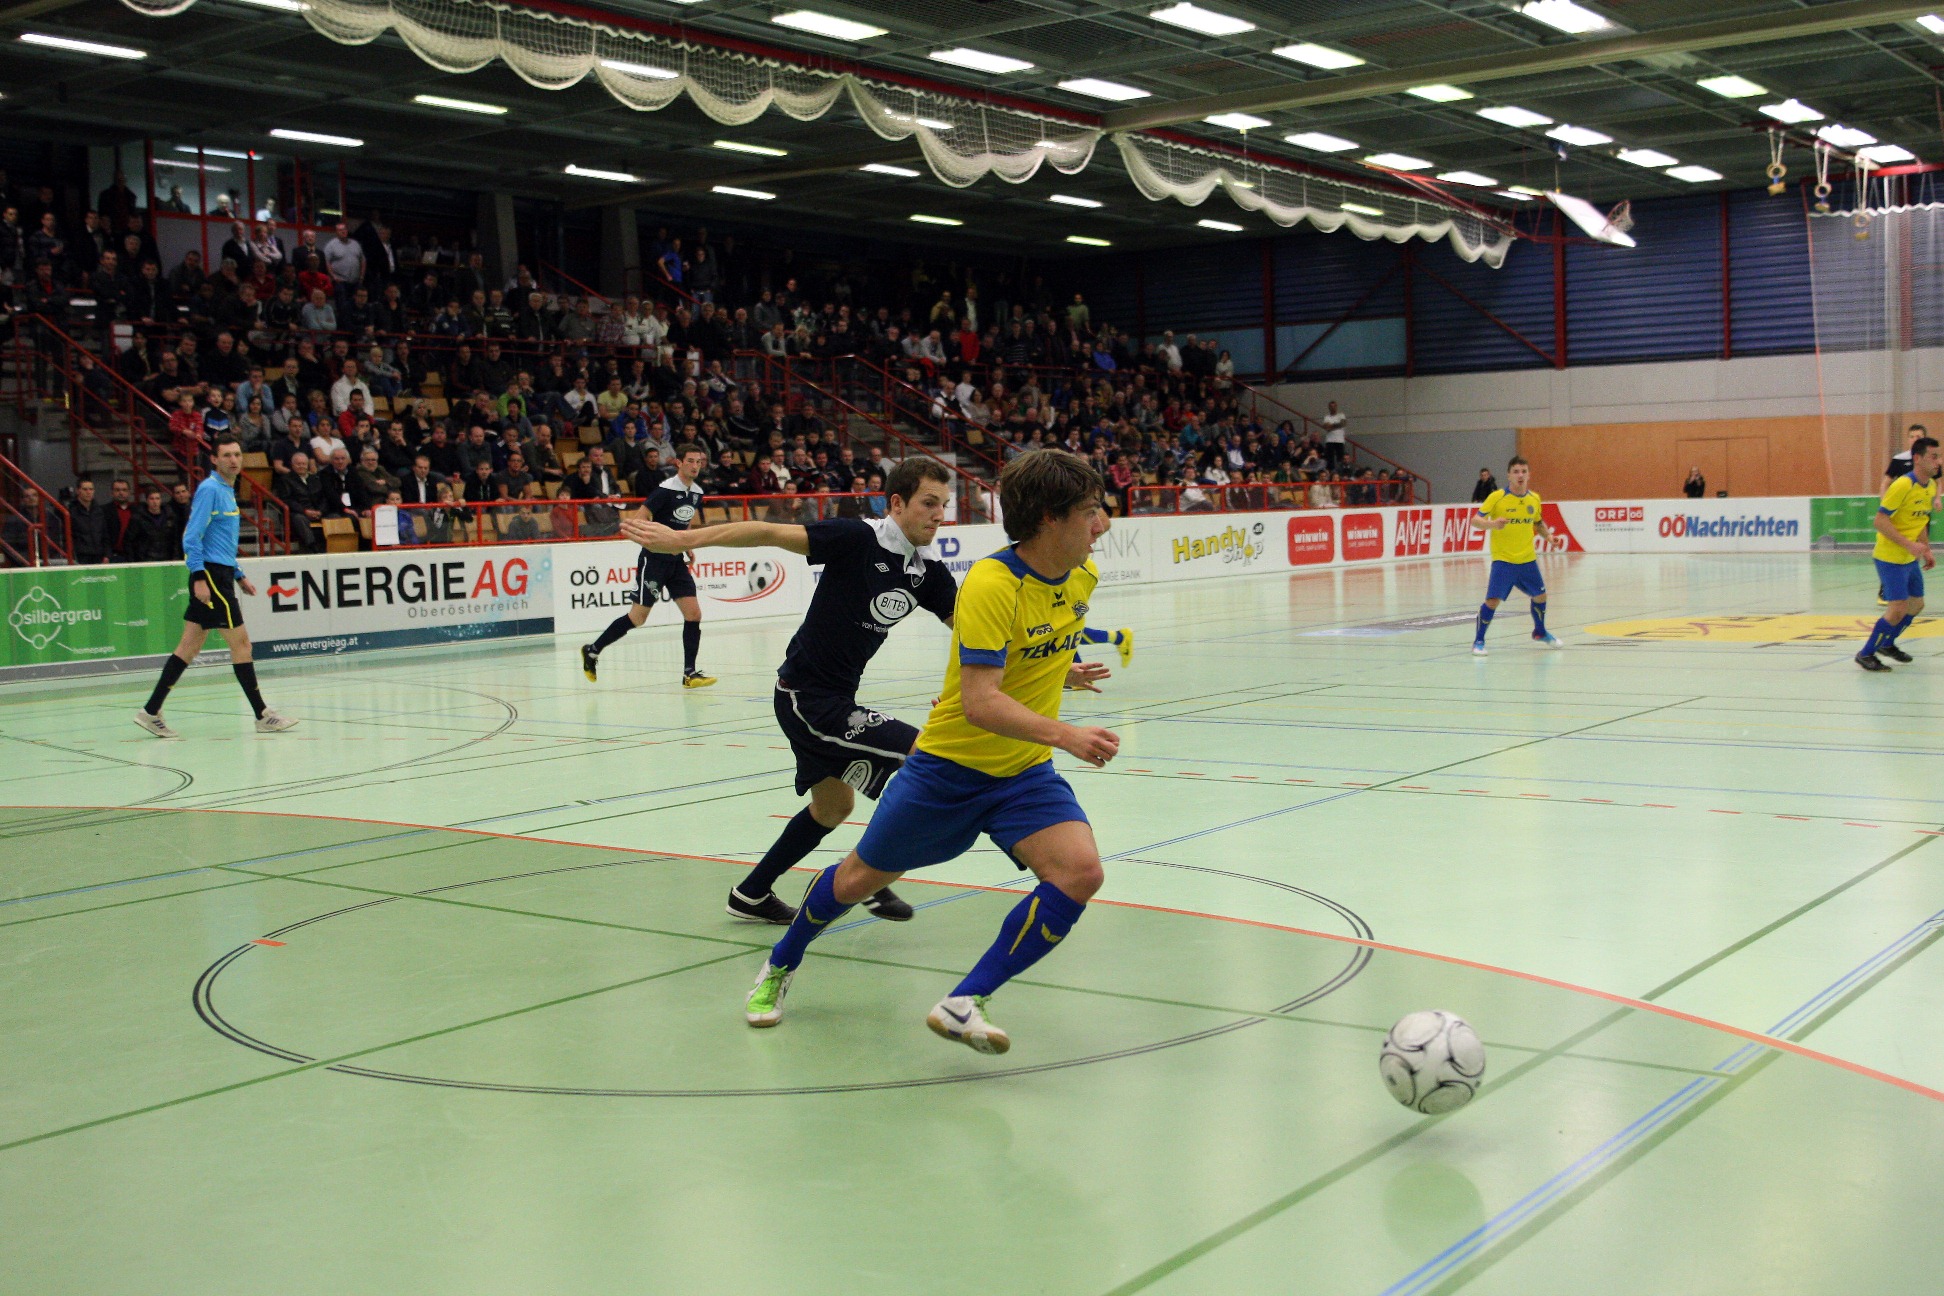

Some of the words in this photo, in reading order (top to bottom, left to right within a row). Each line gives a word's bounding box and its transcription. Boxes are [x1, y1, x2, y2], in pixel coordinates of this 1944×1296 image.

[1596, 509, 1626, 520] ORF
[1395, 519, 1430, 546] AVE
[1658, 514, 1799, 538] OÖNachrichten
[1092, 528, 1141, 560] ANK
[1172, 525, 1246, 564] Handy
[570, 567, 599, 587] OÖ
[1120, 569, 1141, 580] BANK
[267, 561, 467, 614] ENERGIE
[471, 558, 529, 599] AG
[24, 609, 101, 626] silbergrau
[408, 599, 529, 619] Oberösterreich
[273, 637, 358, 653] www.energieag.at
[845, 724, 866, 740] CNC
